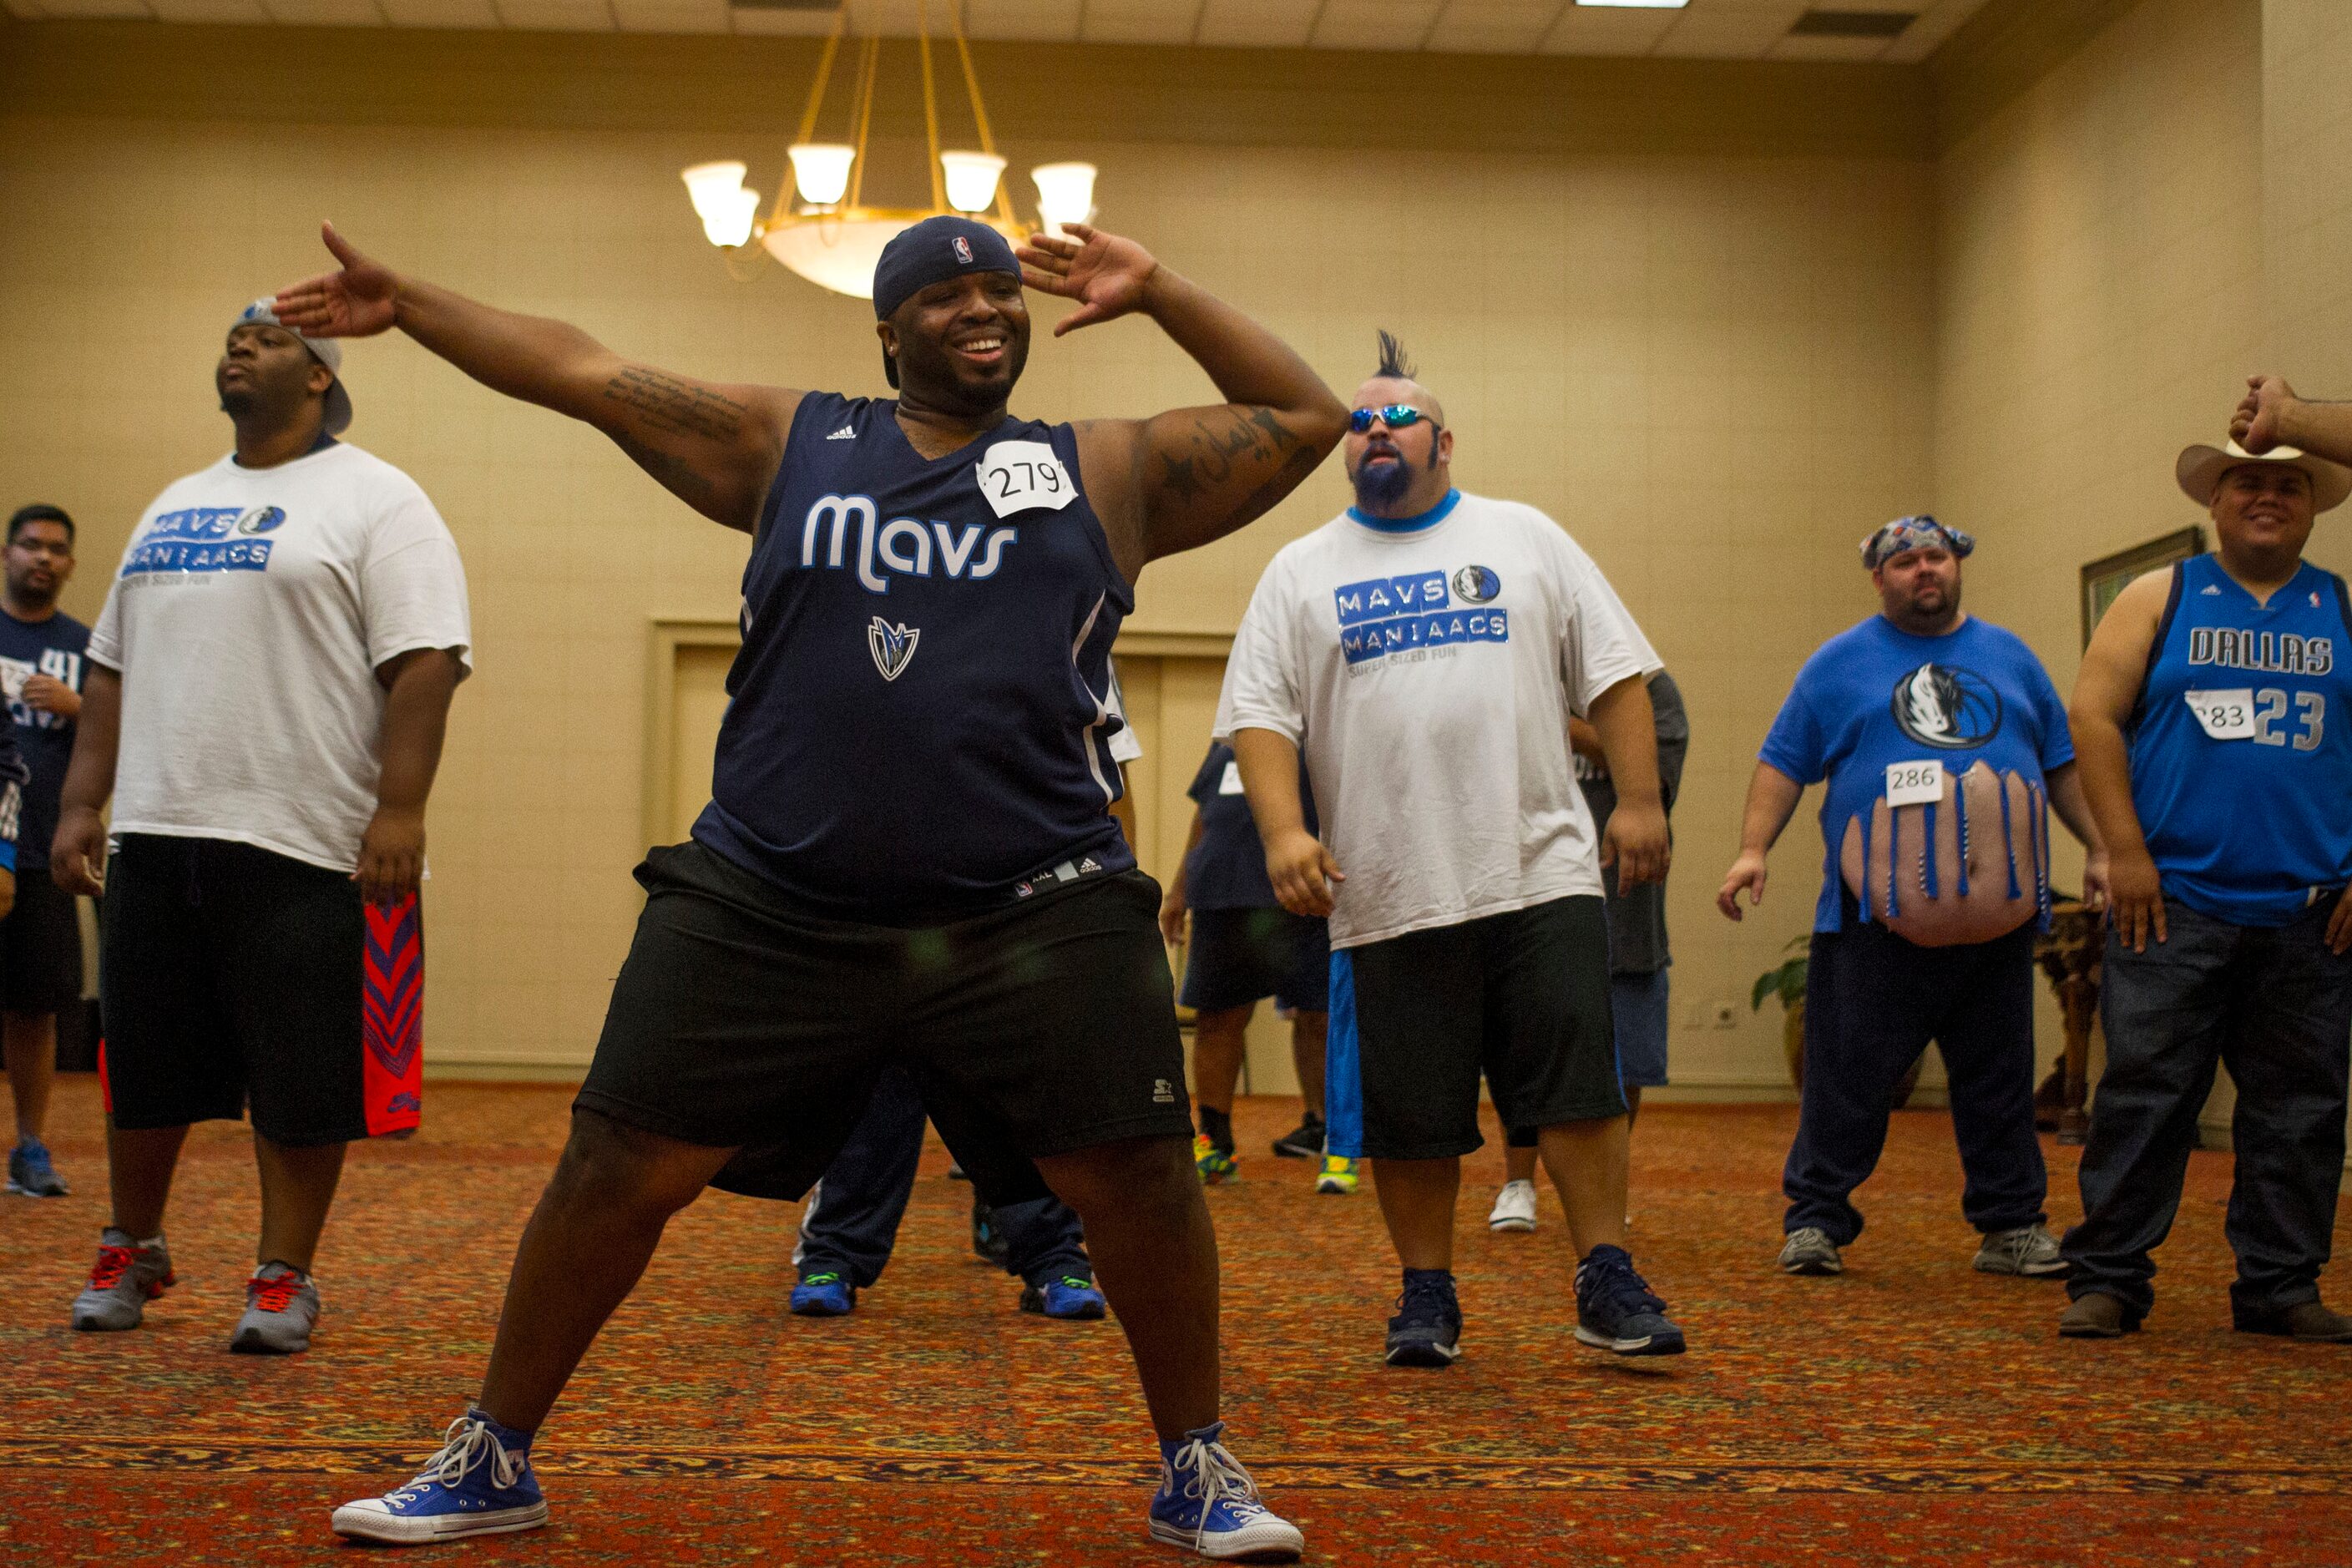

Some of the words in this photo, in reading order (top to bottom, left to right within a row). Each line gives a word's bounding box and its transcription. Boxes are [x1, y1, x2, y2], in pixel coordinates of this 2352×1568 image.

[988, 462, 1060, 498] 279
[1338, 579, 1444, 617] MAVS
[1343, 615, 1506, 655] MANIAACS
[2188, 627, 2333, 676] DALLAS
[1390, 650, 1426, 665] SIZED
[1431, 645, 1457, 660] FUN
[2253, 687, 2325, 751] 23
[1891, 767, 1935, 790] 286
